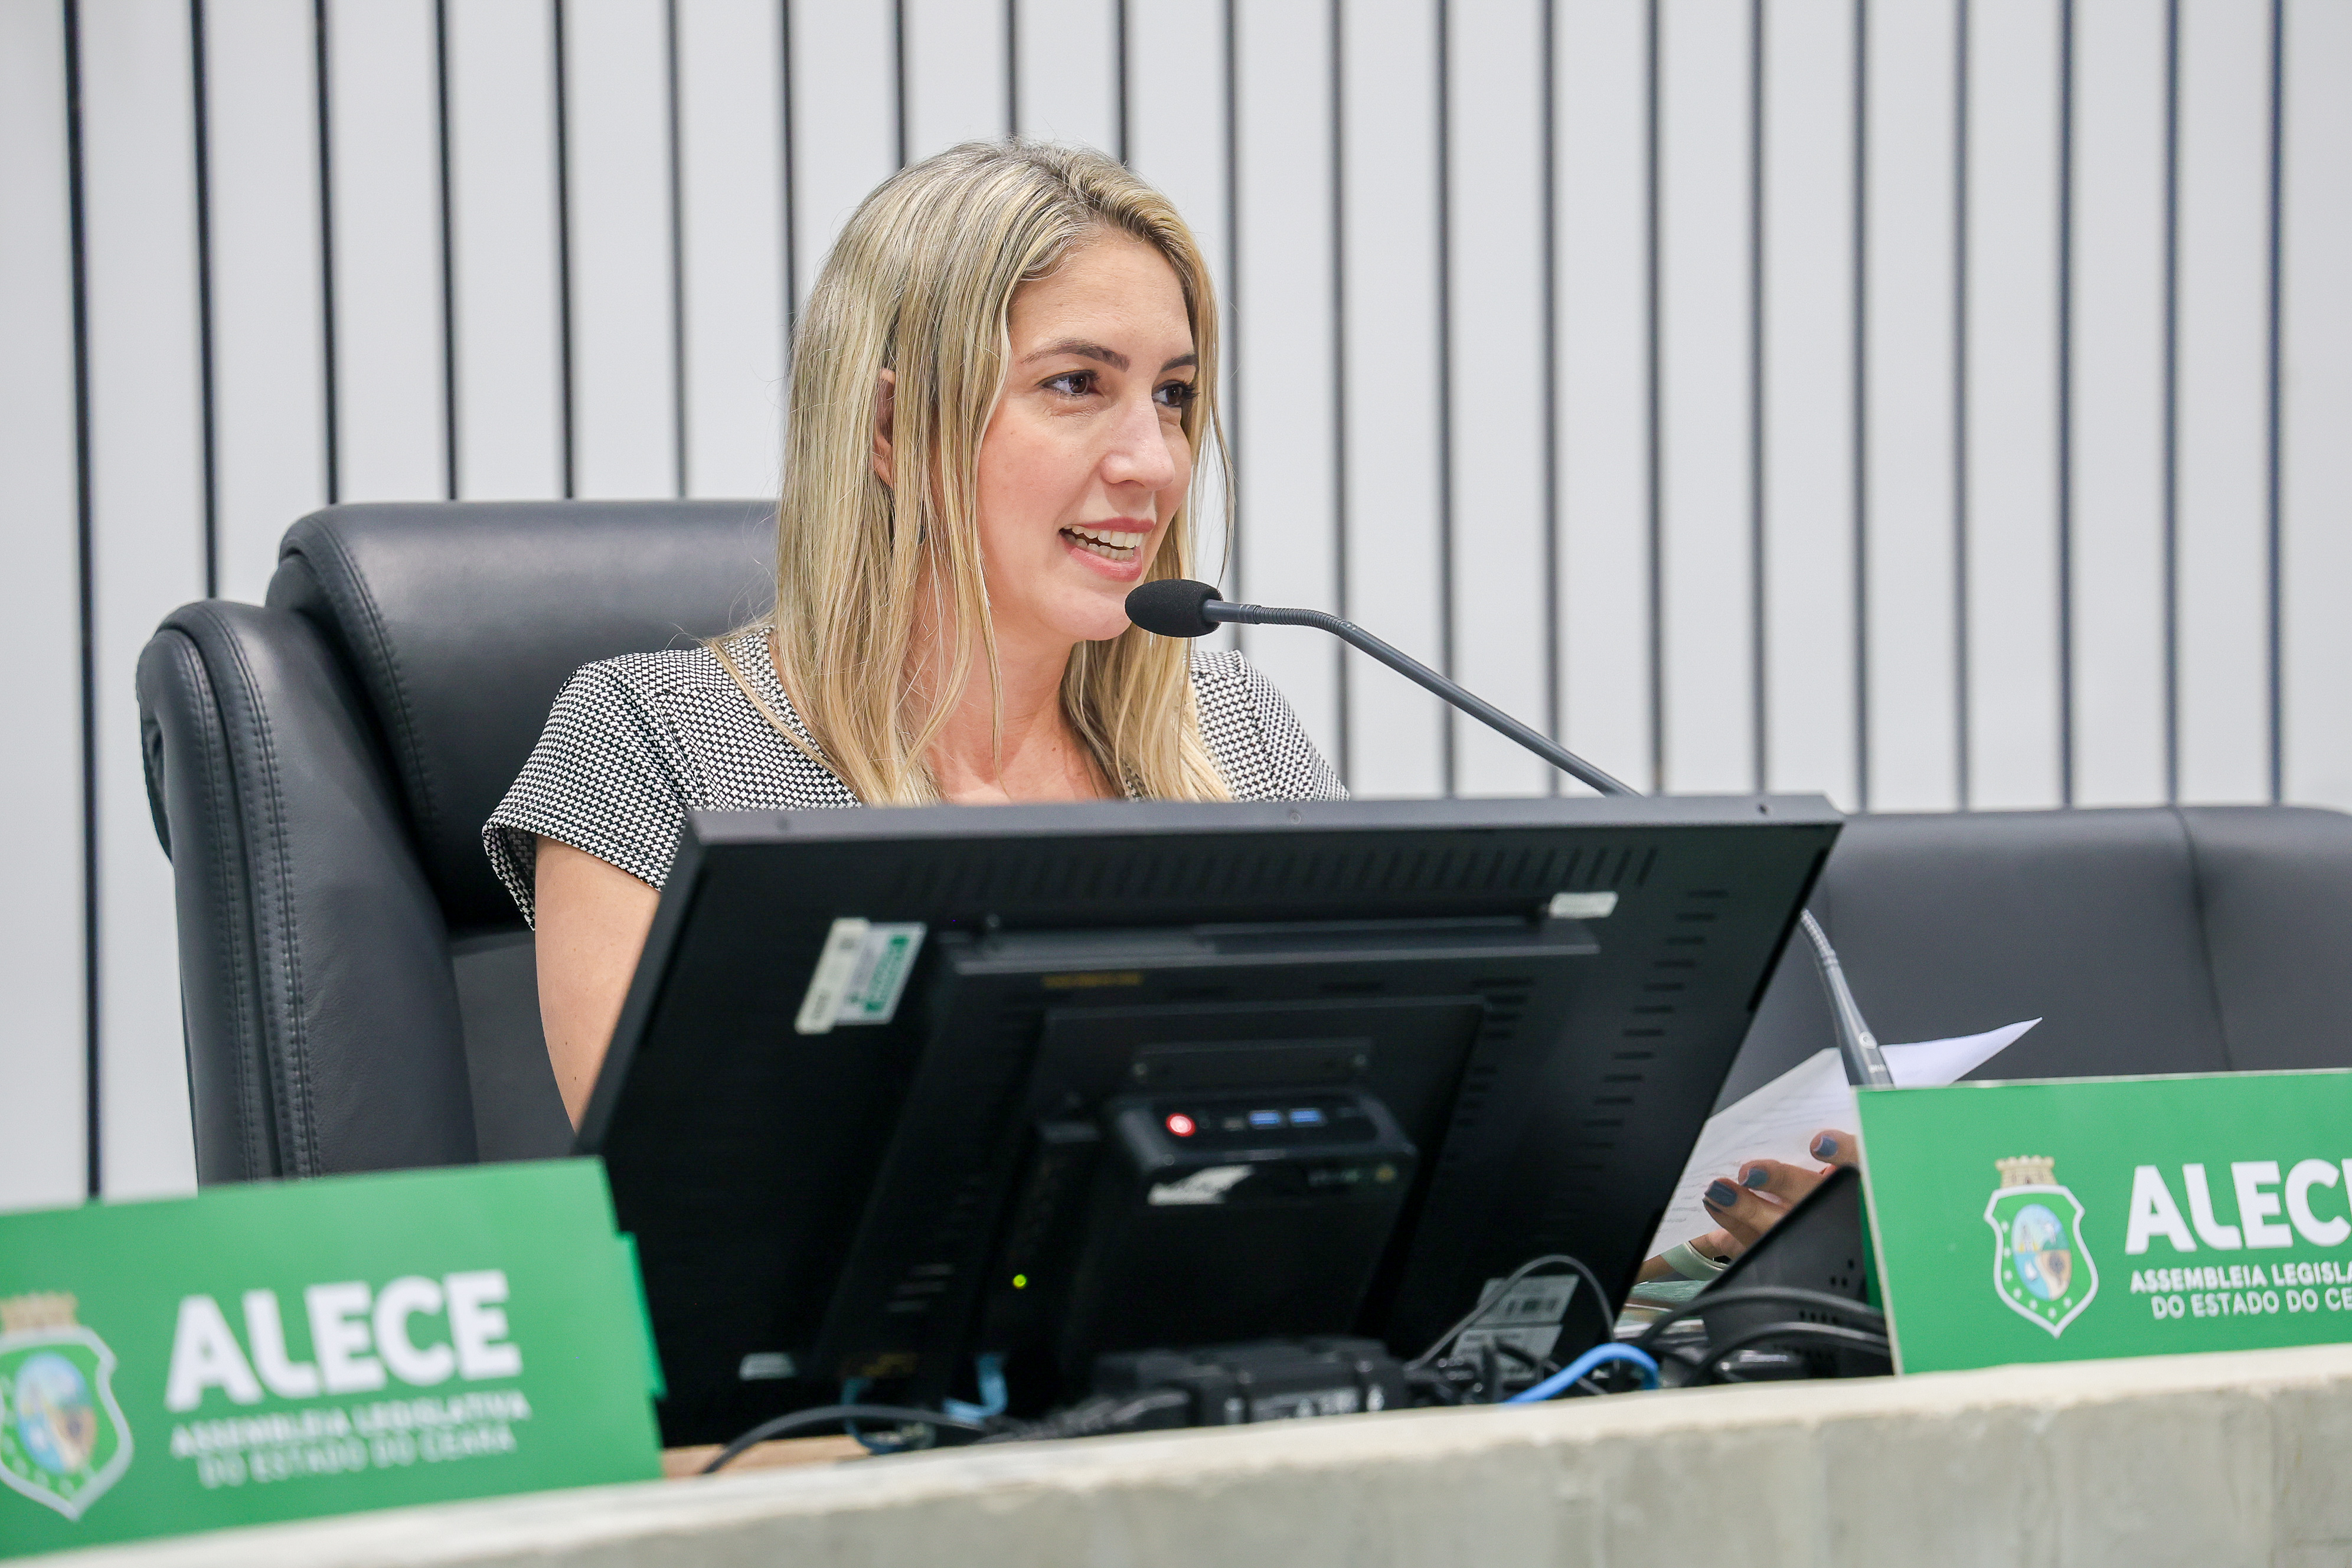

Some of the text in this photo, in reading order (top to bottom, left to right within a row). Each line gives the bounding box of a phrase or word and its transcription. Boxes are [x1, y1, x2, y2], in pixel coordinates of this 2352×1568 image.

[2125, 1159, 2352, 1255] ALEC
[2130, 1265, 2268, 1294] ASSEMBLEIA
[2151, 1295, 2184, 1320] DO
[2191, 1291, 2279, 1318] ESTADO
[2285, 1288, 2319, 1314] DO
[165, 1269, 523, 1412] ALECE
[170, 1389, 532, 1458] ASSEMBLEIA LEGISLATIVA
[197, 1449, 247, 1489] DO
[250, 1435, 368, 1483] ESTADO
[370, 1430, 417, 1468] DO
